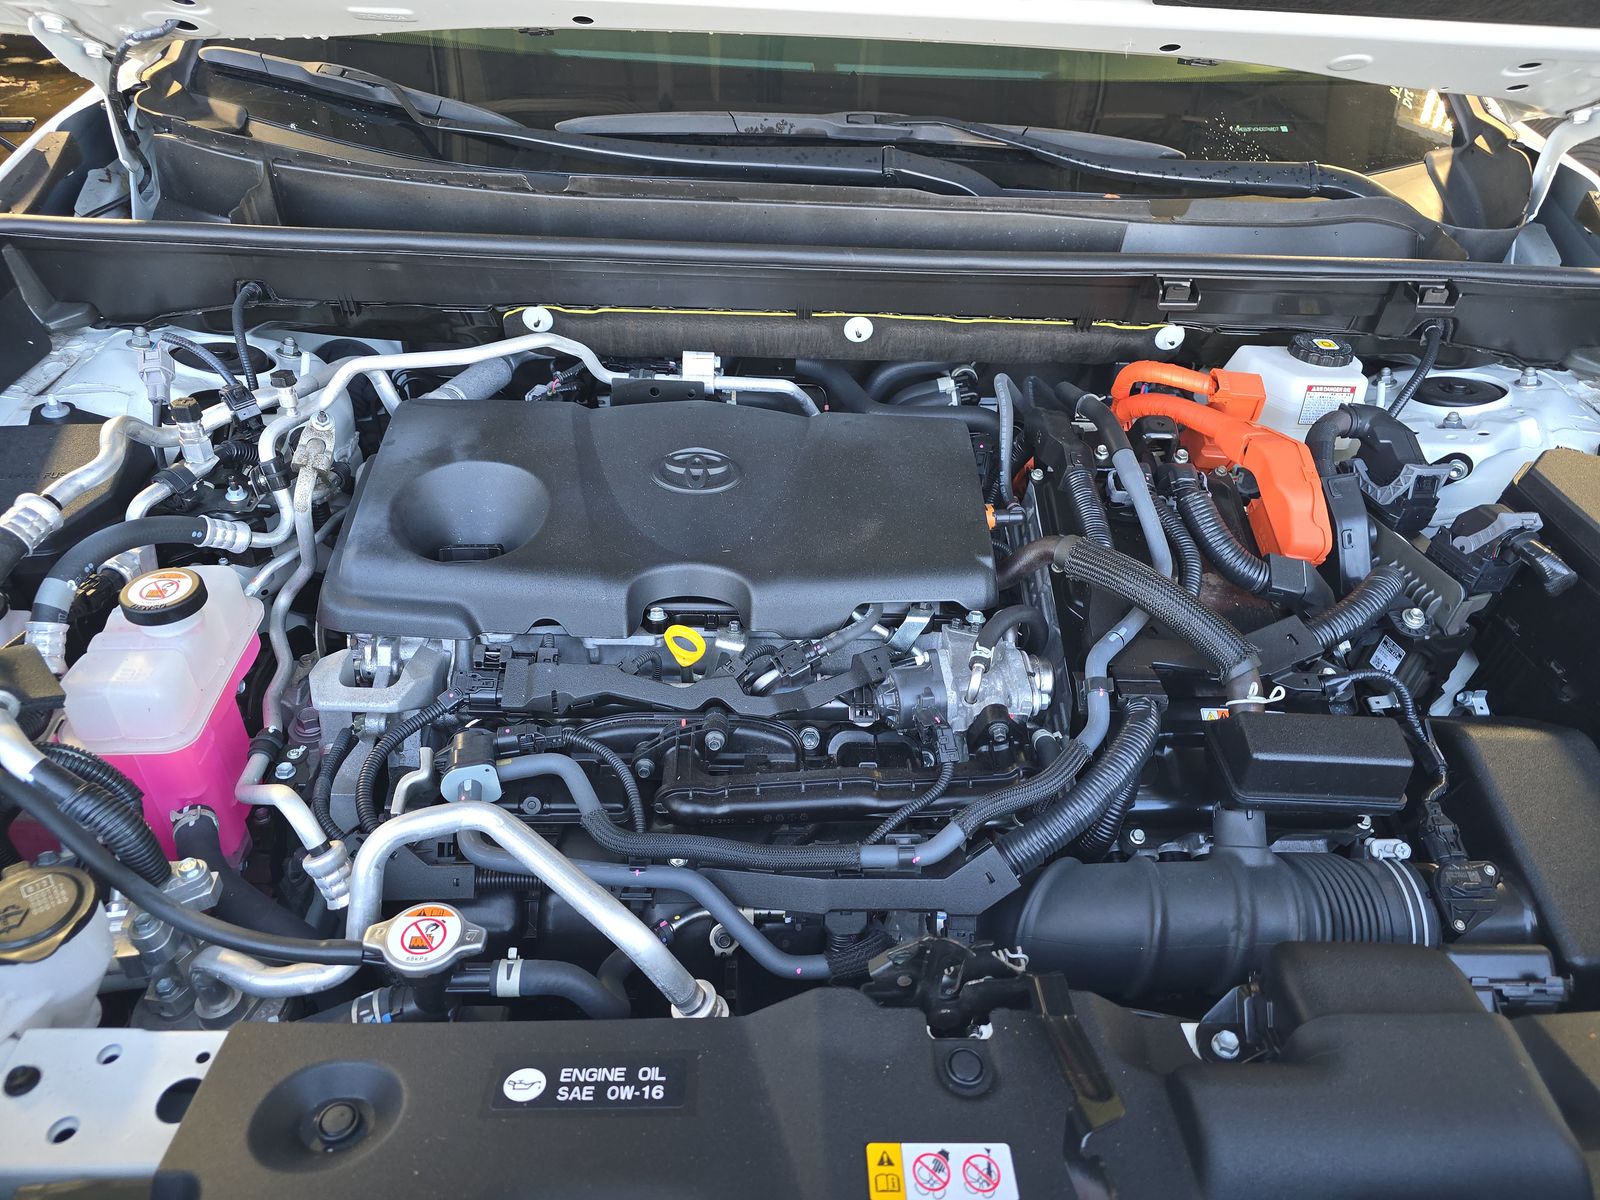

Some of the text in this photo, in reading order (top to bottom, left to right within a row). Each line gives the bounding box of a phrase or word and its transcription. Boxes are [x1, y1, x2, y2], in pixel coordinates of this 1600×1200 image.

[559, 1067, 667, 1082] ENGINE OIL
[556, 1085, 665, 1101] SAE 0W-16
